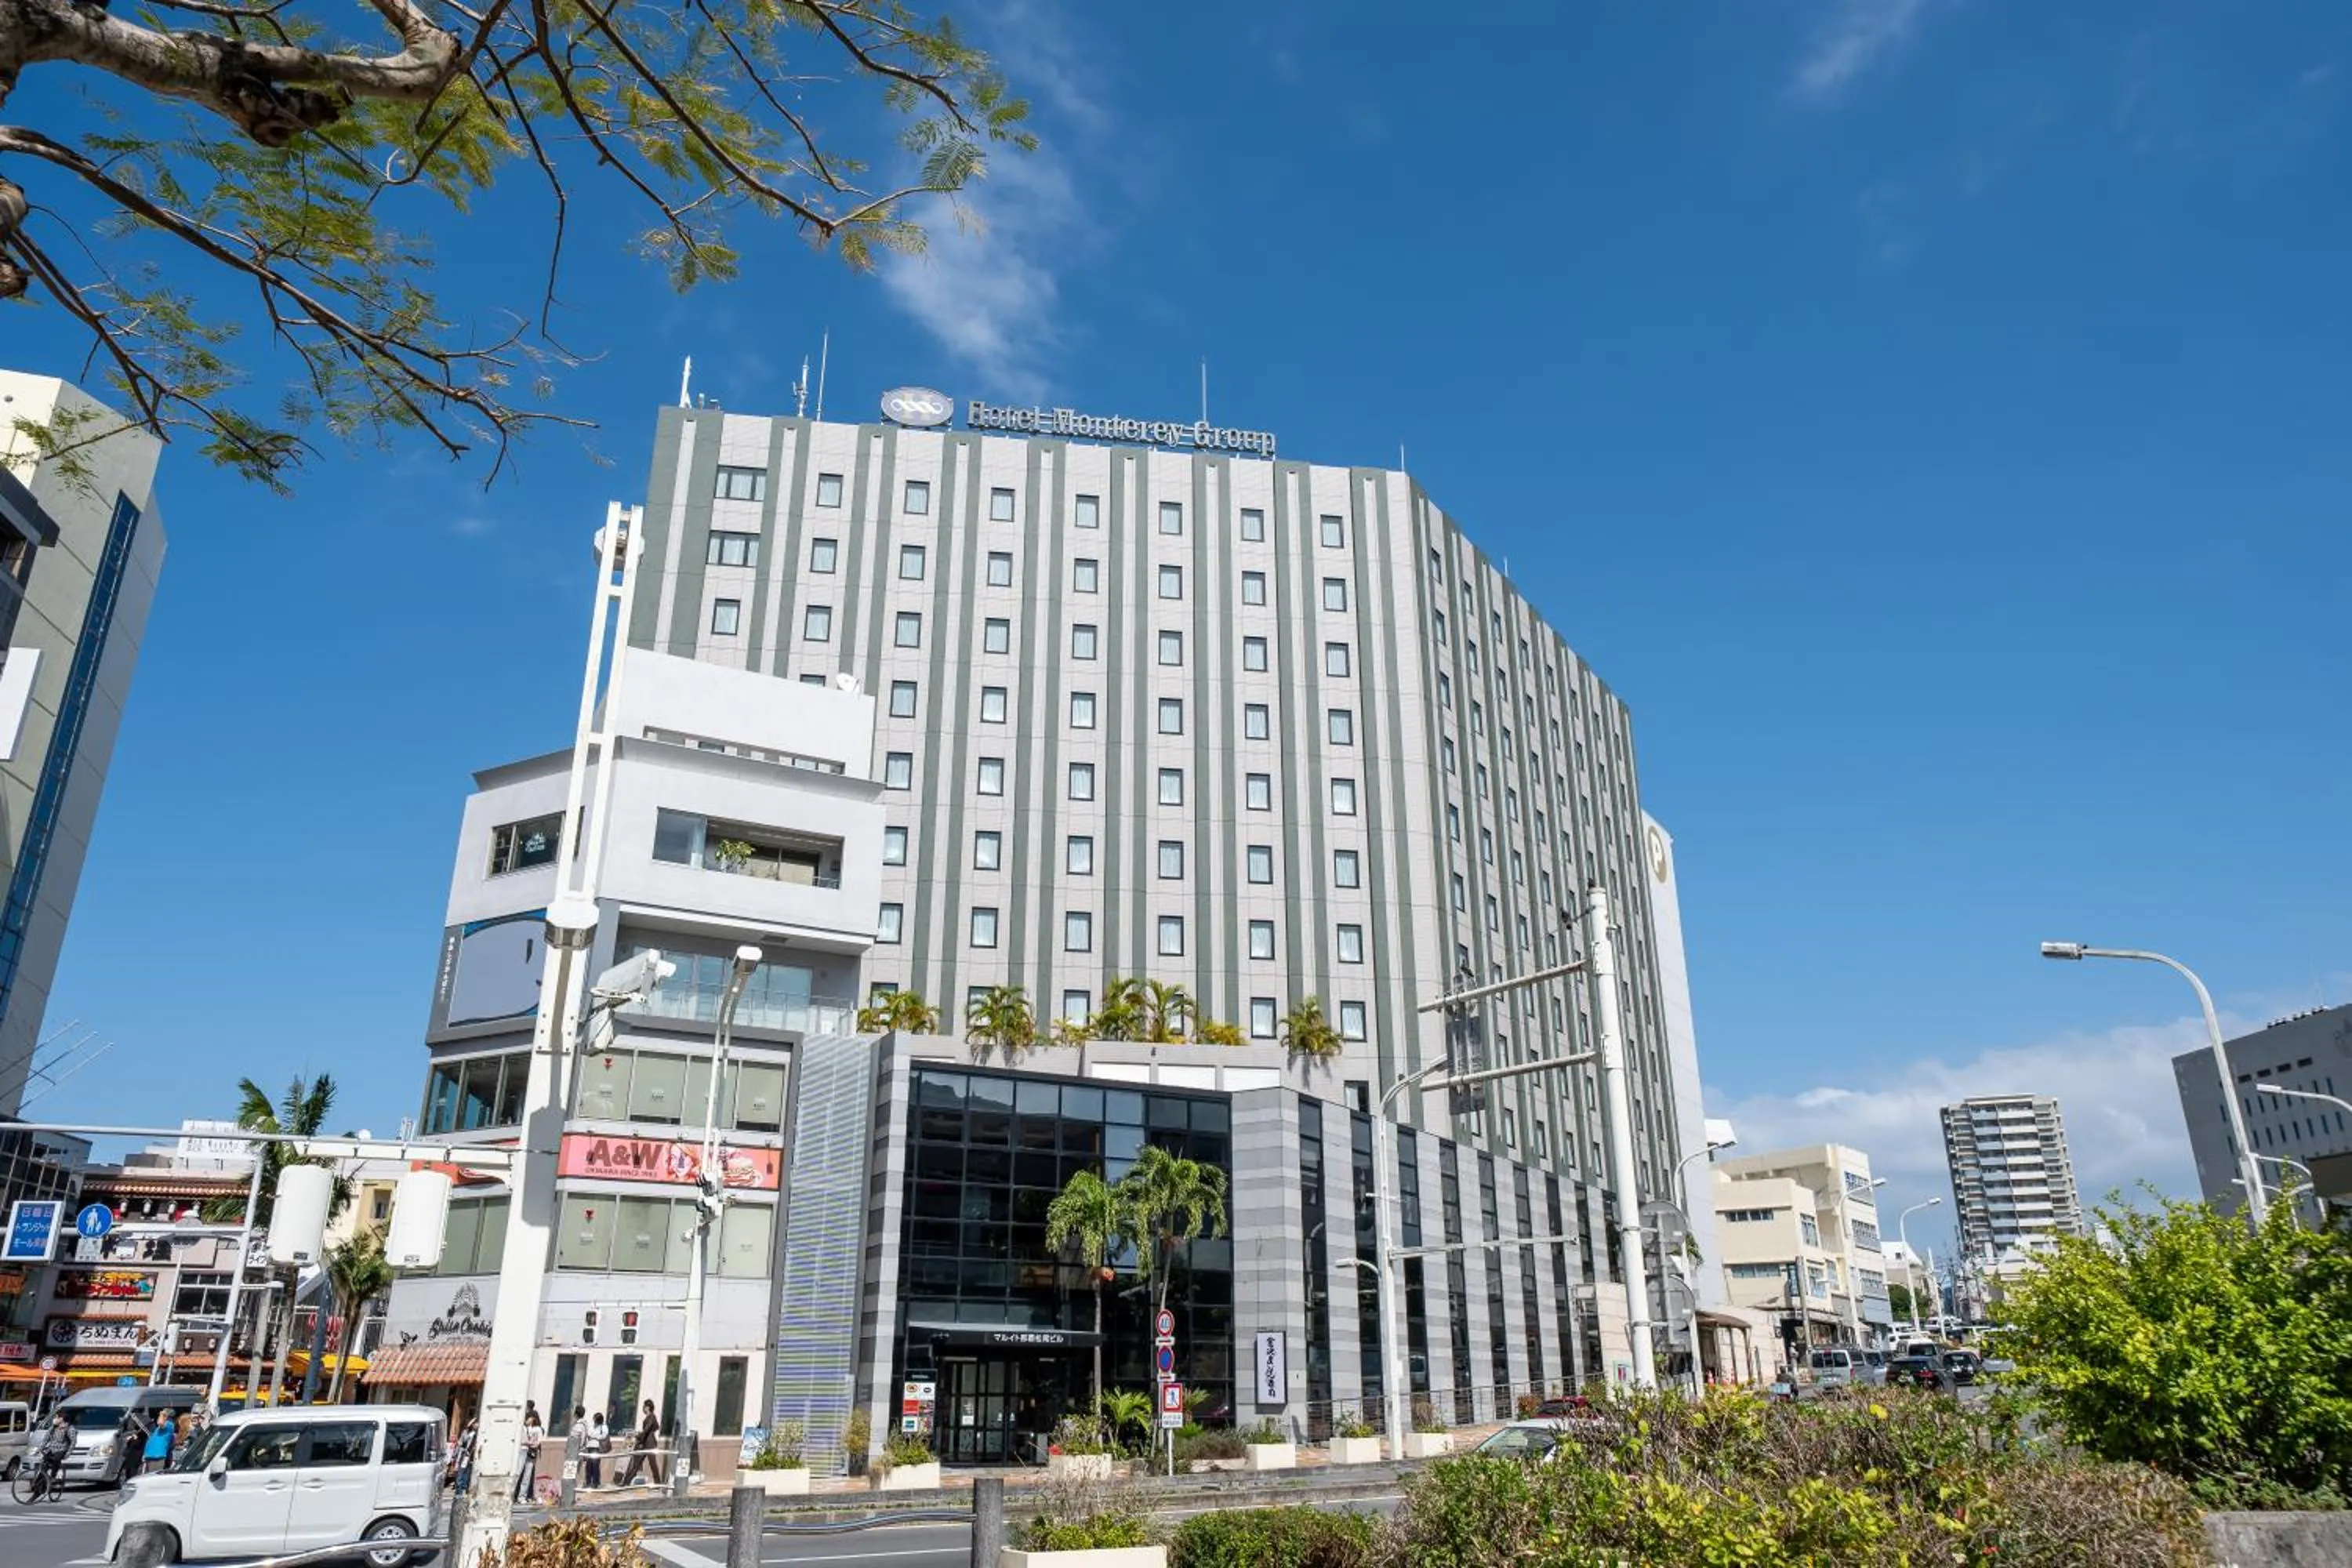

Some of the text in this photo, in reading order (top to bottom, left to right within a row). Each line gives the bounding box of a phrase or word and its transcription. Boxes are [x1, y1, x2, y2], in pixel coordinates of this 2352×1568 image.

[968, 401, 1276, 457] Hotel Monterey Group
[587, 1140, 663, 1170] A&W
[79, 1325, 138, 1340] ちぬまん
